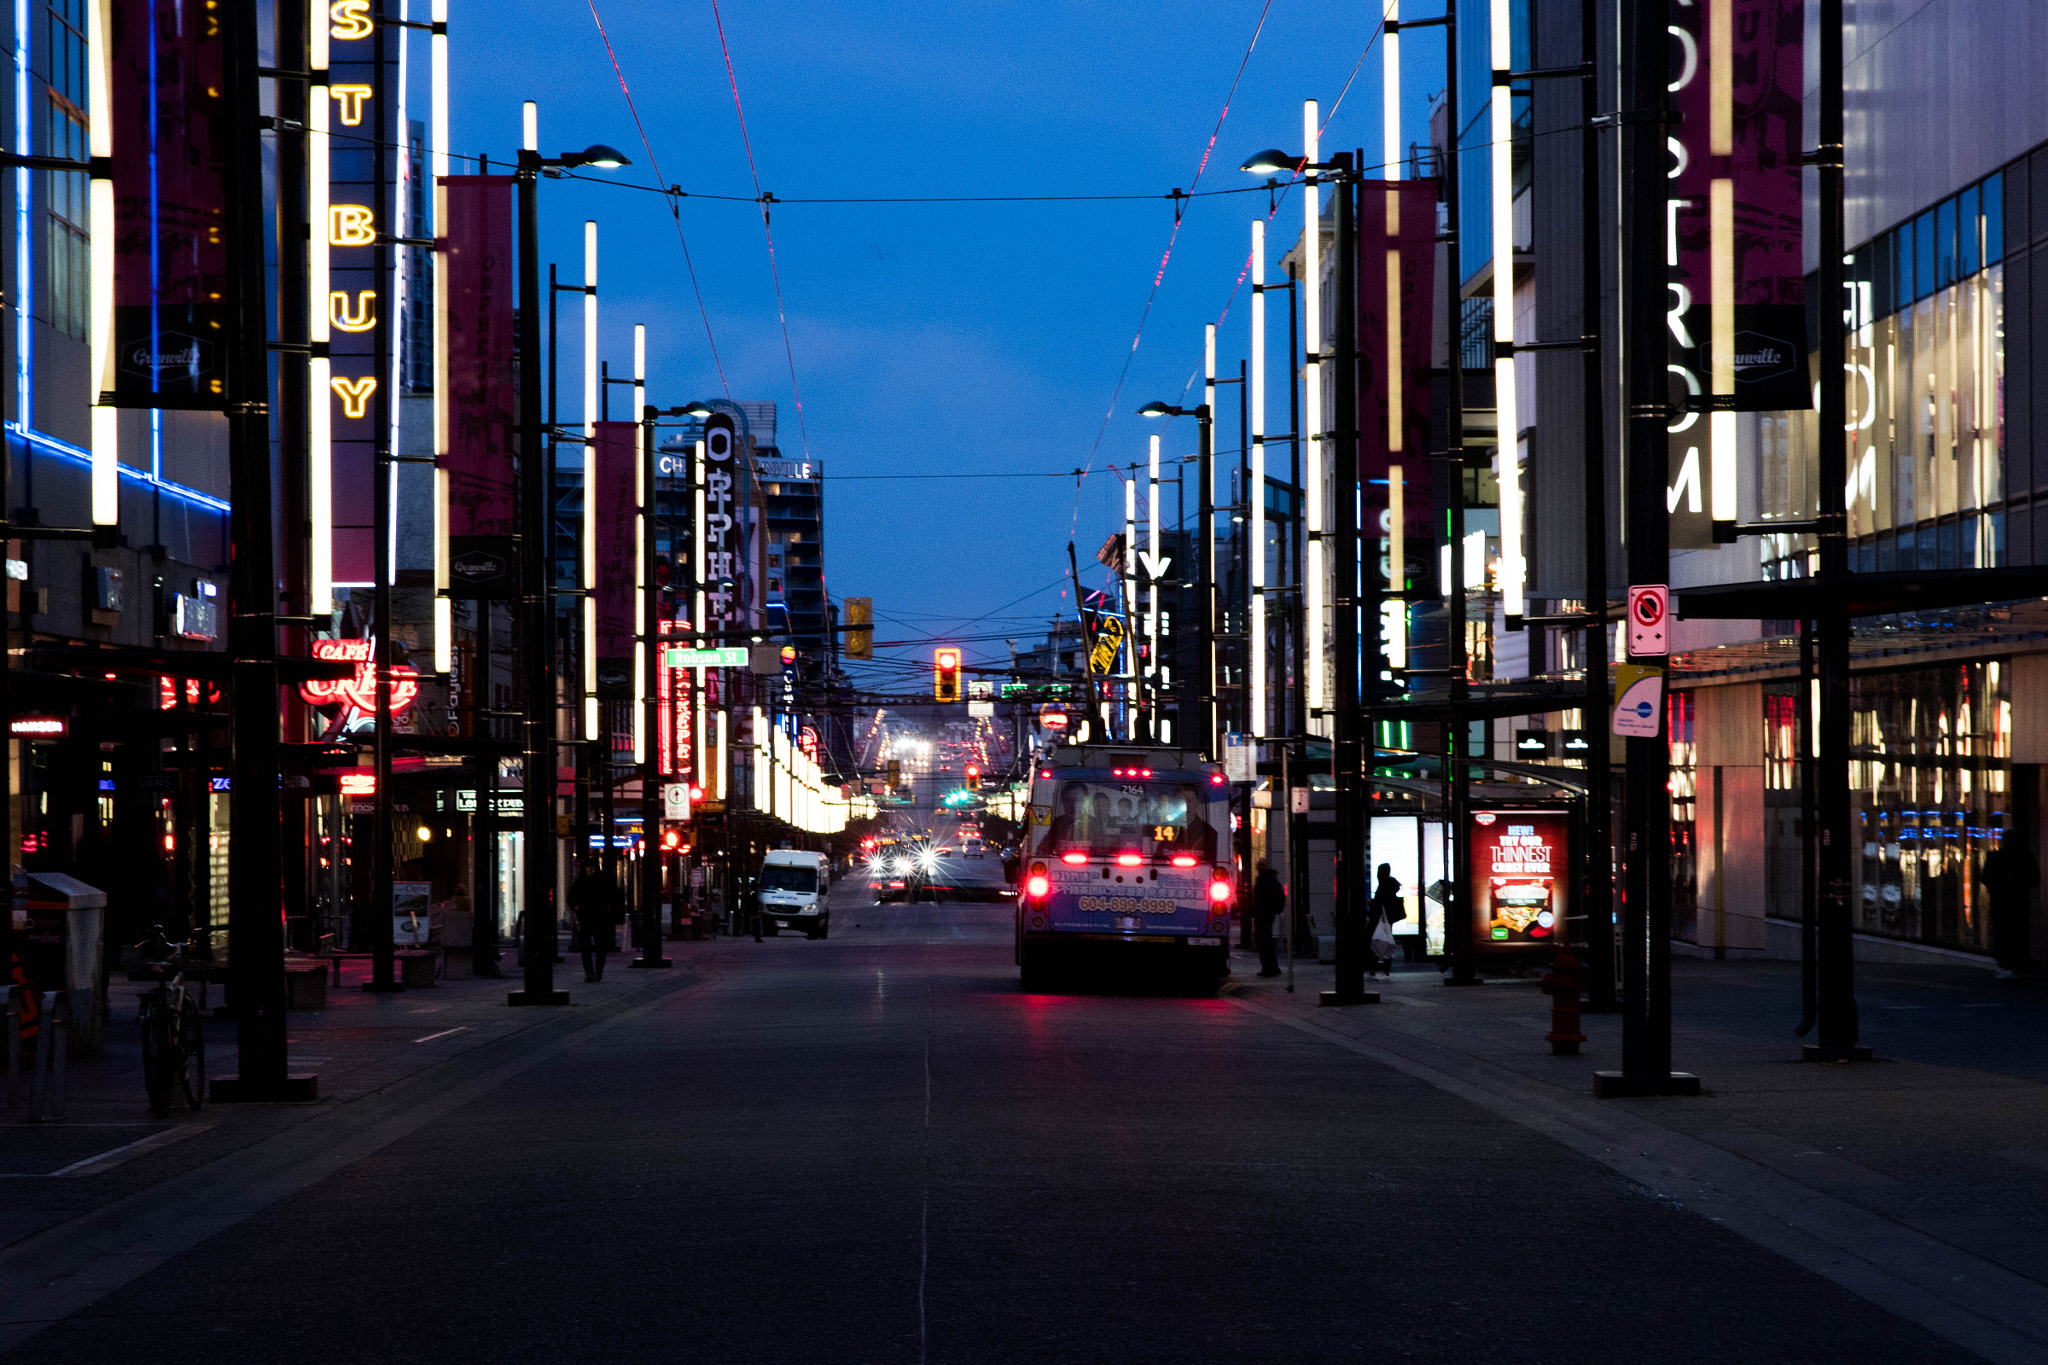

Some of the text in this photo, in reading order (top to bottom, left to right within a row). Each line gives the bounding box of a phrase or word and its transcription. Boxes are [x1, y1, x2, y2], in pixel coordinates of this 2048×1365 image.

[329, 204, 377, 419] BUY
[675, 651, 738, 664] Robson St
[1122, 785, 1144, 795] 2164
[1154, 826, 1175, 842] 14
[1507, 825, 1534, 836] NEW!
[1499, 836, 1543, 846] TRY OUR
[1490, 846, 1552, 862] THINNEST
[1491, 862, 1550, 873] CRUST EVER
[1079, 897, 1177, 914] 604-899-9999
